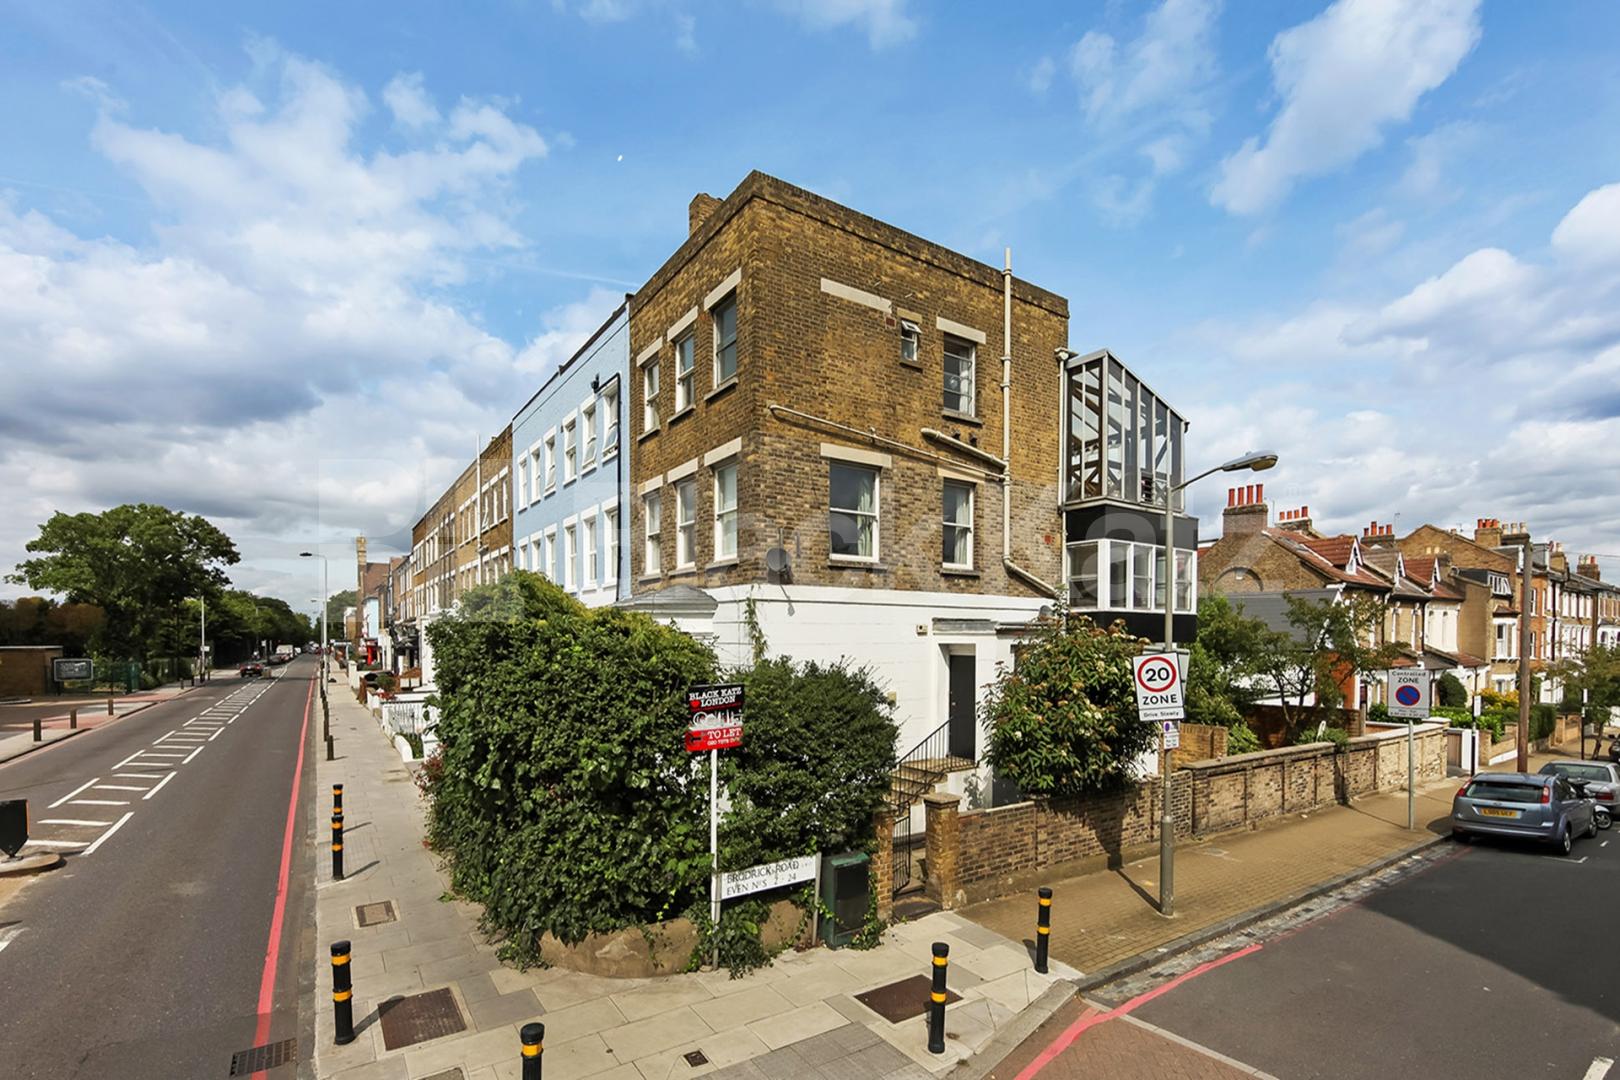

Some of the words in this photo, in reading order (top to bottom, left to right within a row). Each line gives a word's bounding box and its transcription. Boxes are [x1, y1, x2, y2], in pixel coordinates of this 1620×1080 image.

[1145, 667, 1170, 682] 20
[689, 691, 719, 701] BLACK
[721, 687, 742, 697] KATZ
[1142, 694, 1178, 705] ZONE
[701, 696, 735, 707] LONDON
[707, 731, 722, 740] TO
[723, 727, 742, 738] LET
[727, 866, 772, 883] BRODRICK
[775, 860, 799, 873] ROAD
[726, 883, 749, 896] EVEN
[787, 873, 797, 882] 24
